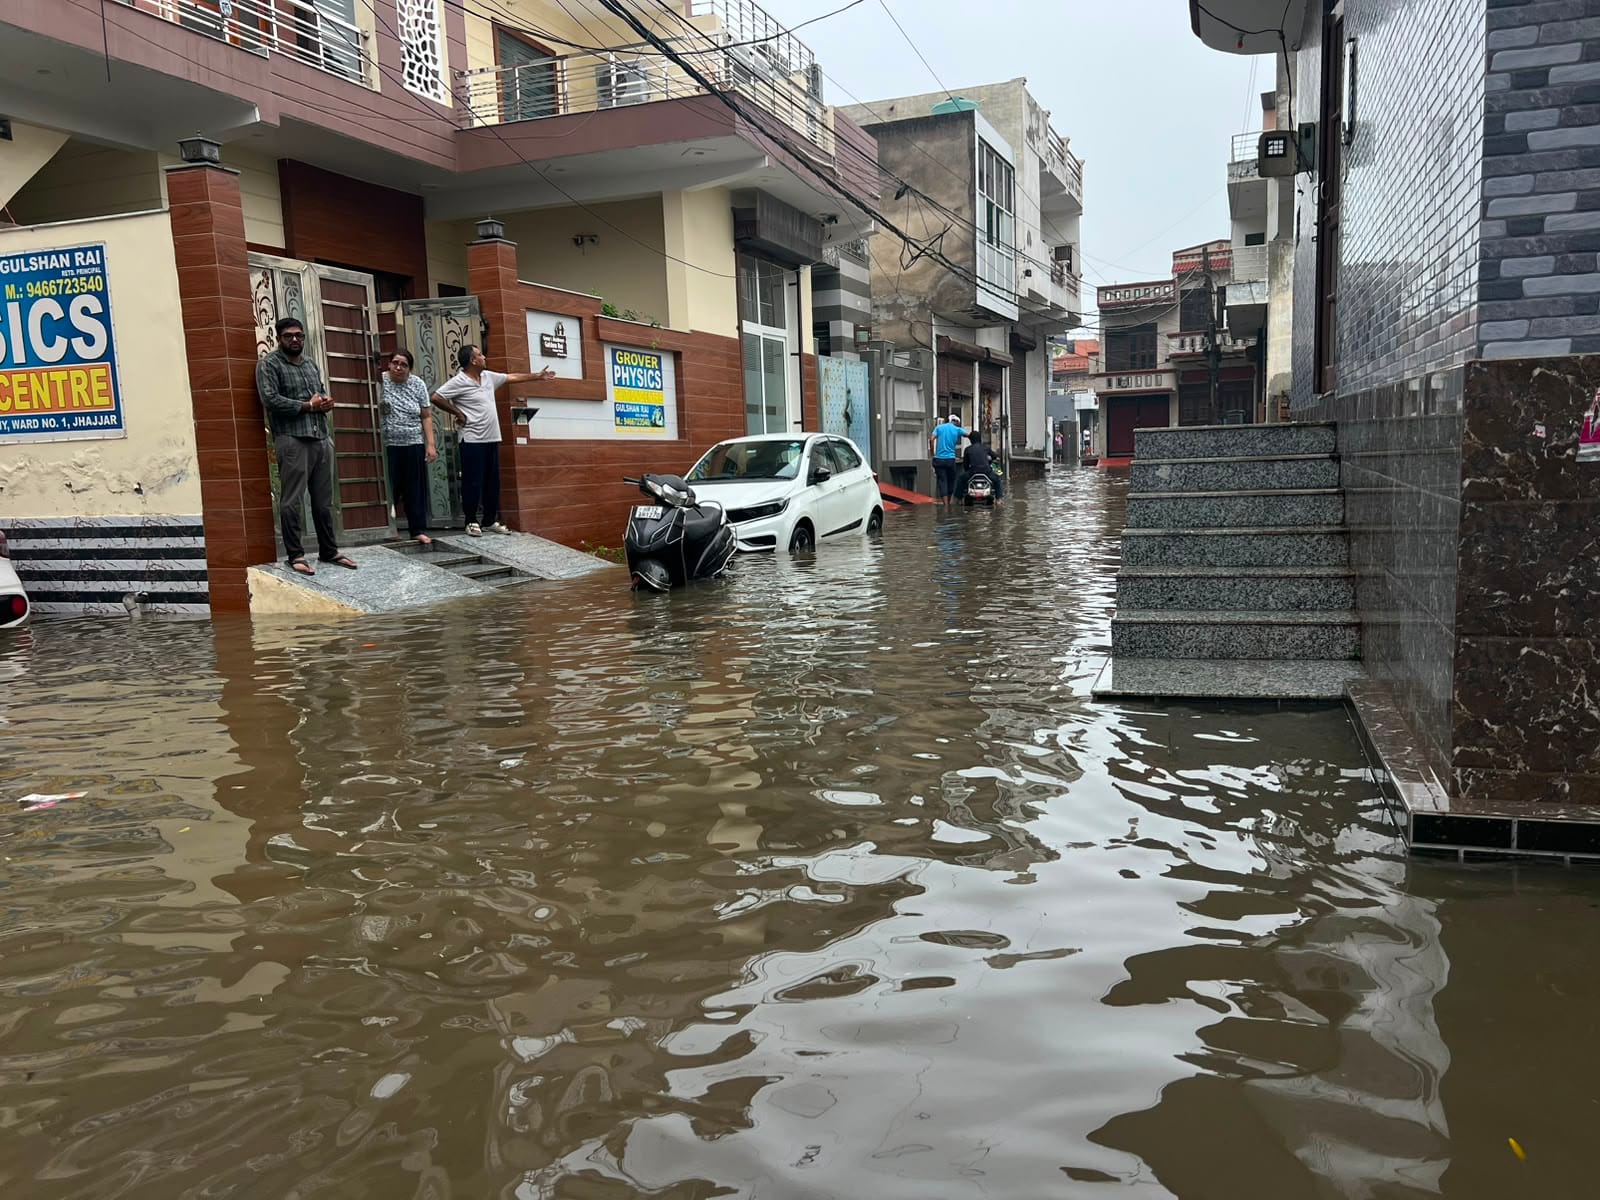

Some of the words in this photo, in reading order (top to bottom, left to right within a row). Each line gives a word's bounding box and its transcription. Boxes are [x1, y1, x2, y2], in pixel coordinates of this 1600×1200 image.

[0, 253, 70, 274] GULSHAN
[75, 250, 100, 266] RAI
[76, 267, 102, 275] PRINCIPAL
[26, 275, 103, 297] 9466723540
[0, 294, 107, 364] ICS
[616, 351, 659, 369] GROVER
[614, 365, 661, 389] PHYSICS
[0, 368, 110, 411] CENTRE
[0, 420, 10, 432] Y,
[11, 418, 39, 430] WARD
[42, 417, 59, 429] NO.
[61, 417, 71, 429] 1,
[73, 414, 118, 427] JHAJJAR
